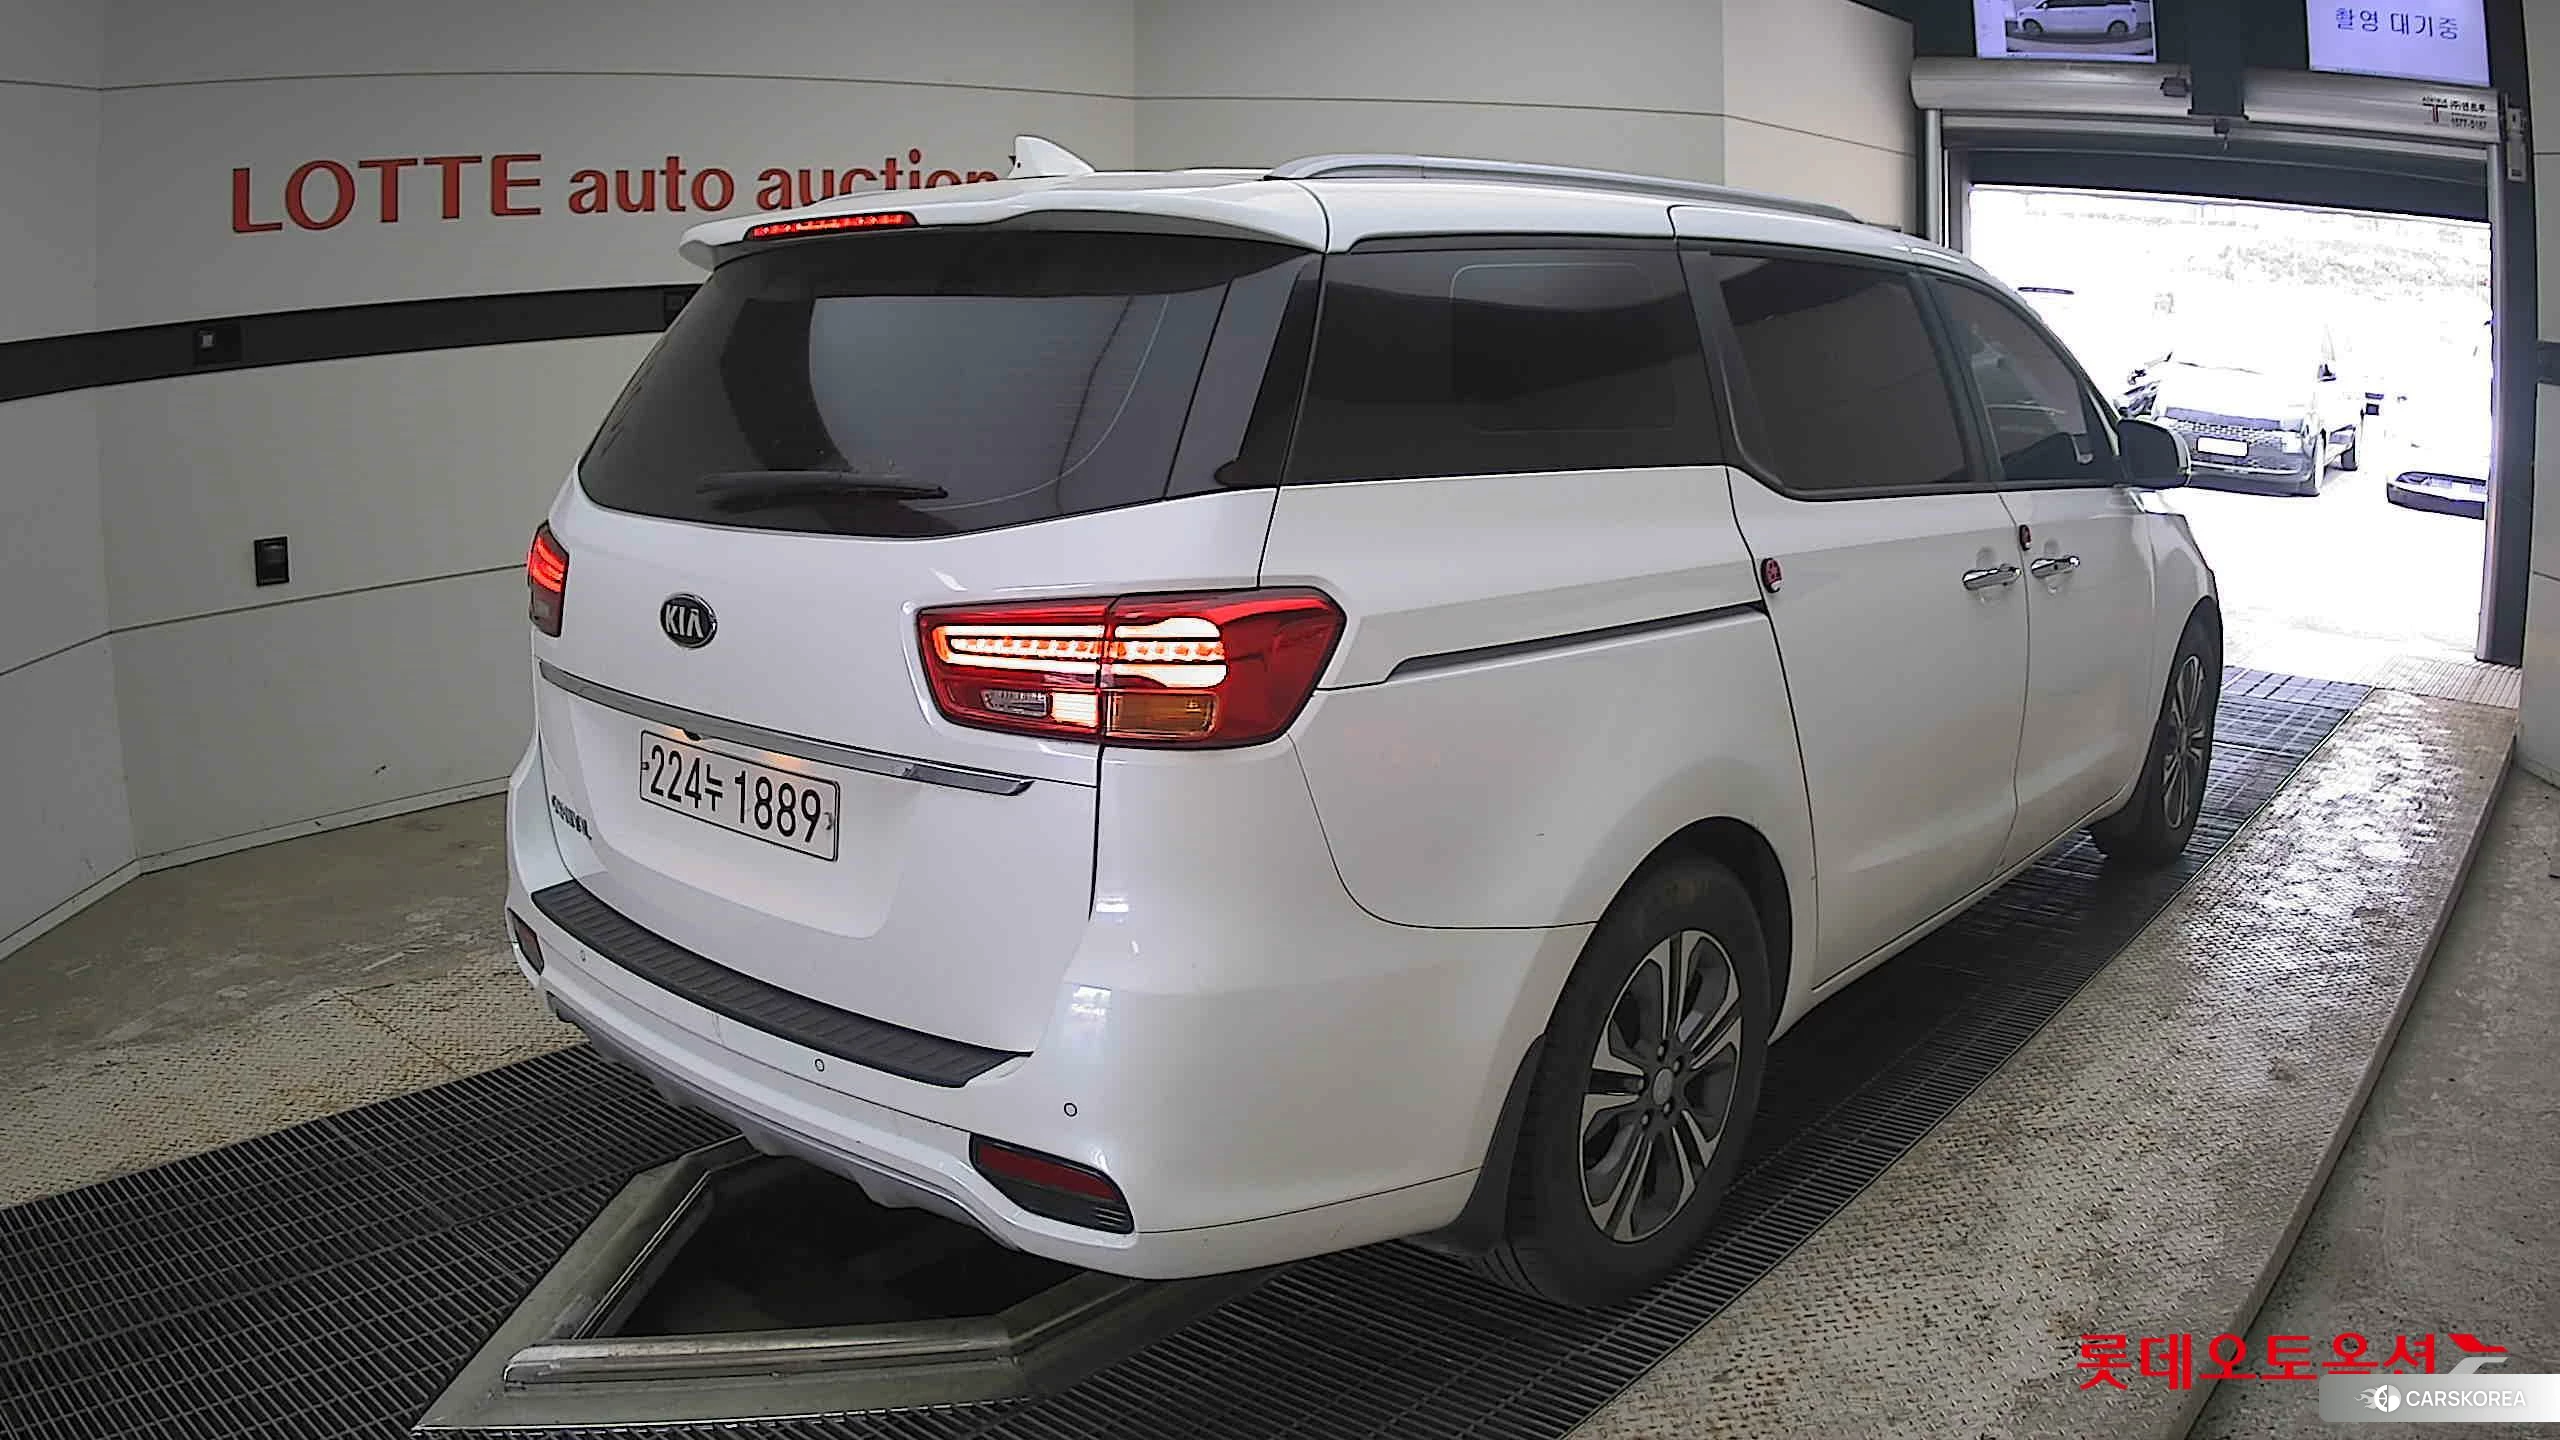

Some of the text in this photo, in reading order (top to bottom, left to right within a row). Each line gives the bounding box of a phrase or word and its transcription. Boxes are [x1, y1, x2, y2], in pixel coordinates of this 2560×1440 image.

[2390, 12, 2458, 40] 대기중
[232, 153, 542, 234] LOTTE
[568, 155, 735, 214] auto
[665, 603, 704, 639] KIA
[734, 770, 821, 843] 1889
